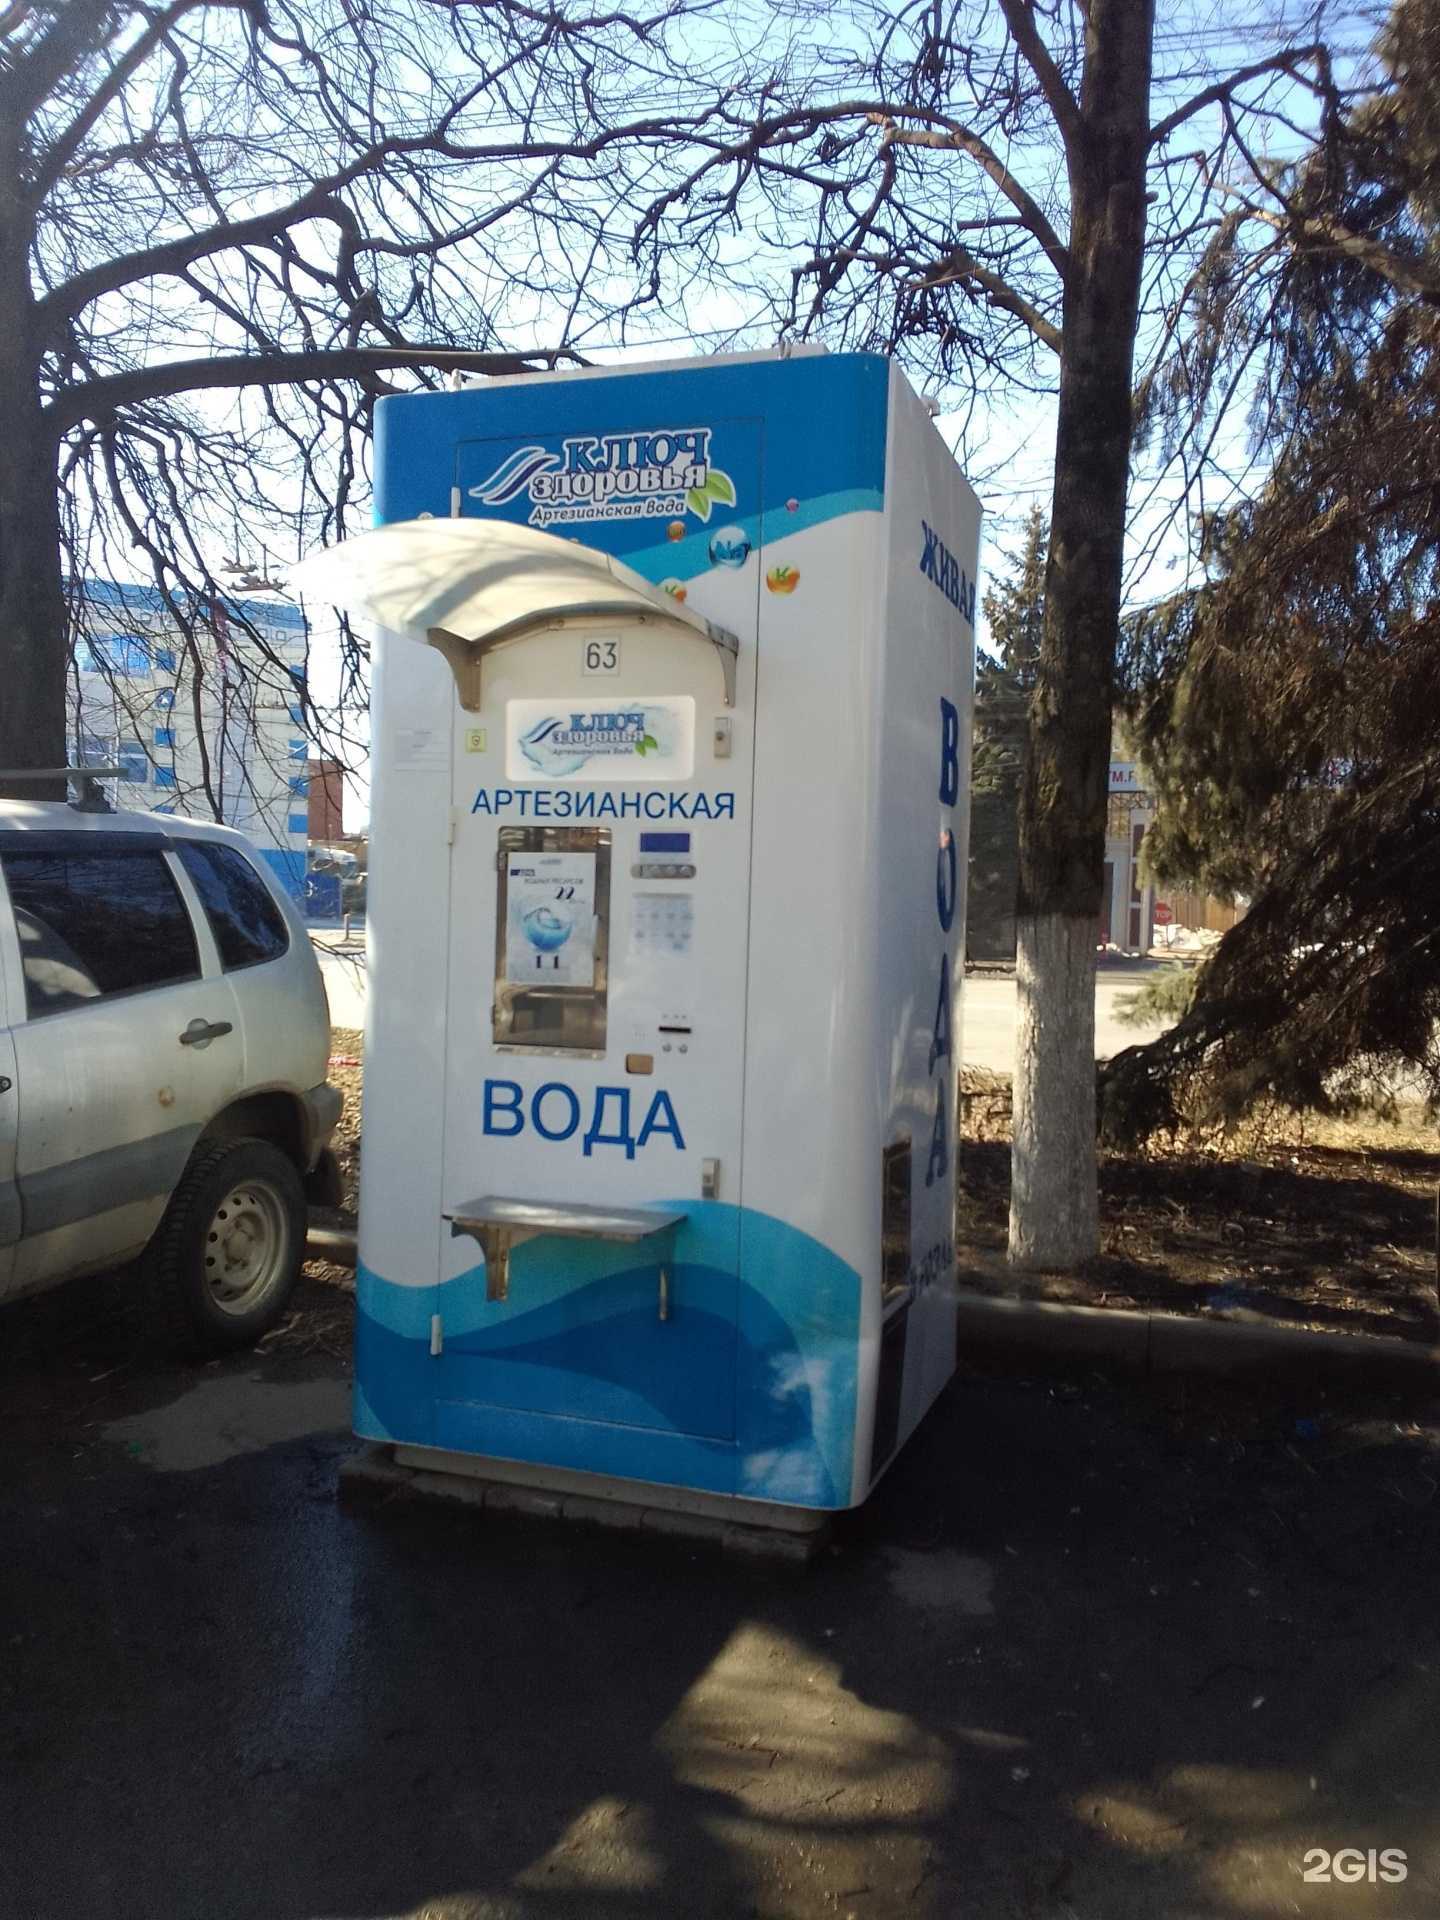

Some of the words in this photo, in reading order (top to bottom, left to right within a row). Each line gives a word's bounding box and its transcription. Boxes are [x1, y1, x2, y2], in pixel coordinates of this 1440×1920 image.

[565, 431, 708, 473] КЛЮЧ
[531, 504, 641, 524] Артезианская
[585, 641, 618, 670] 63
[569, 713, 645, 731] КЛЮЧ
[471, 788, 736, 820] АРТЕЗИАНСКАЯ
[482, 1079, 687, 1160] ВОДА
